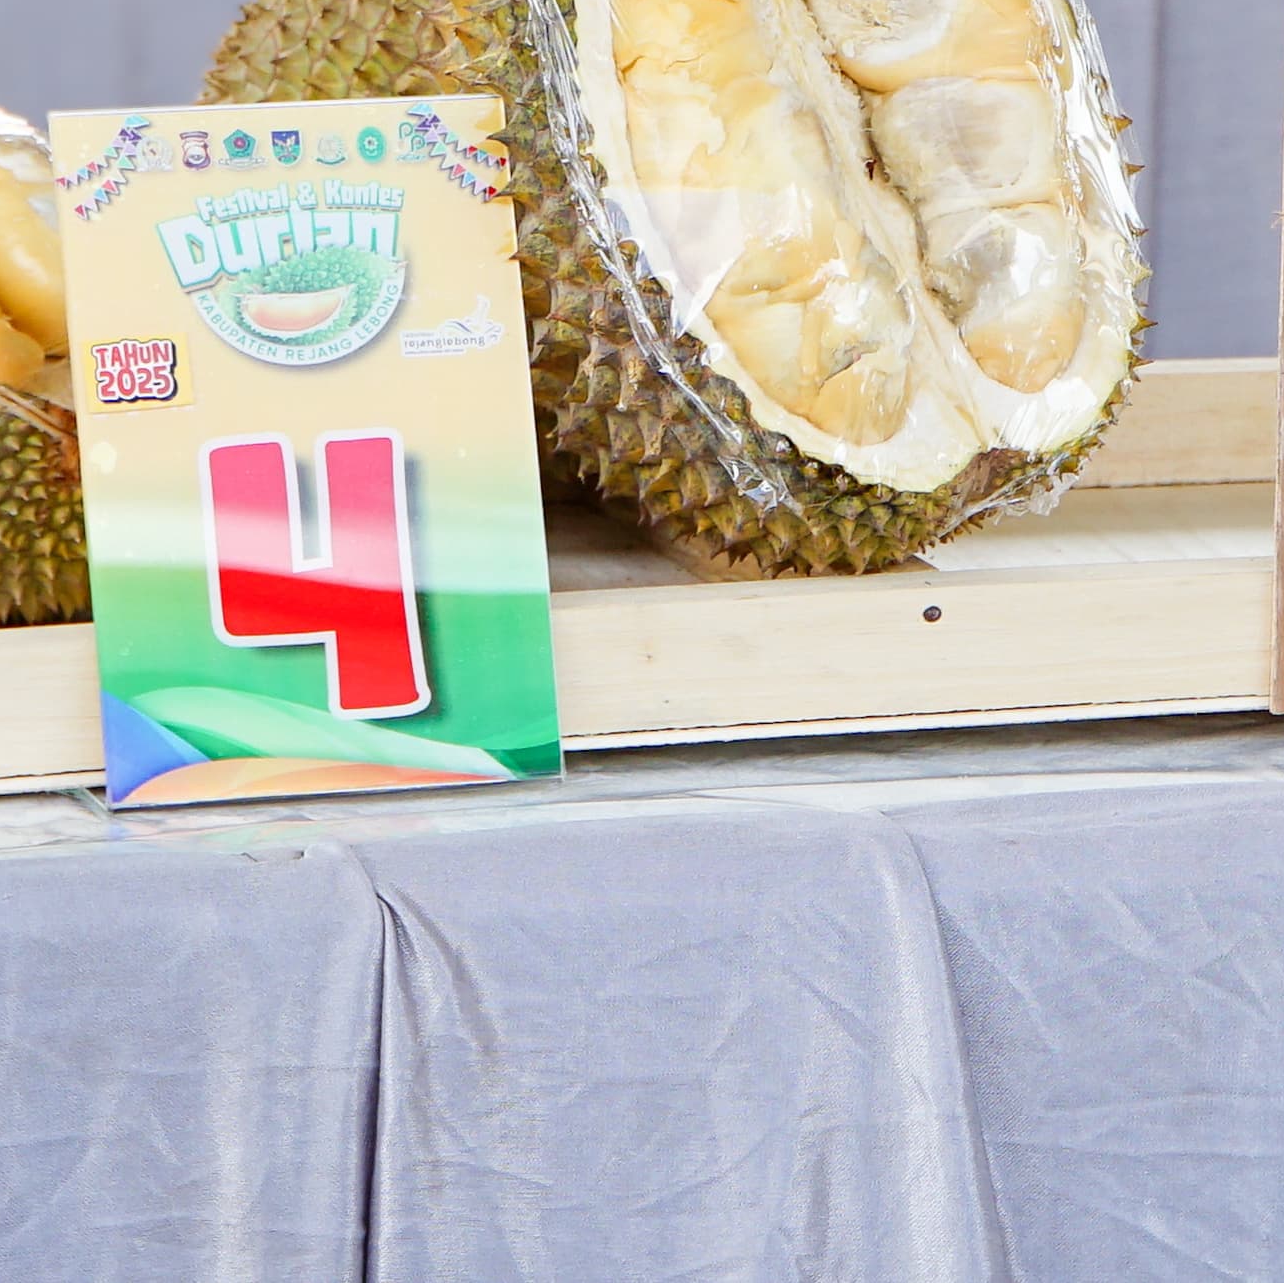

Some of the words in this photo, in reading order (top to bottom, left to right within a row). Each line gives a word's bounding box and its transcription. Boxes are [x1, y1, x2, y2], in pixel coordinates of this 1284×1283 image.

[196, 183, 290, 222] Festival
[297, 181, 318, 209] &
[323, 179, 405, 209] Kontes
[156, 203, 399, 288] Durian
[197, 293, 279, 358] KABUPATEN
[285, 337, 354, 361] REJANG
[355, 283, 399, 343] LEBONG
[95, 342, 170, 369] TAHUN
[99, 365, 172, 397] 2025
[203, 431, 427, 716] 4
